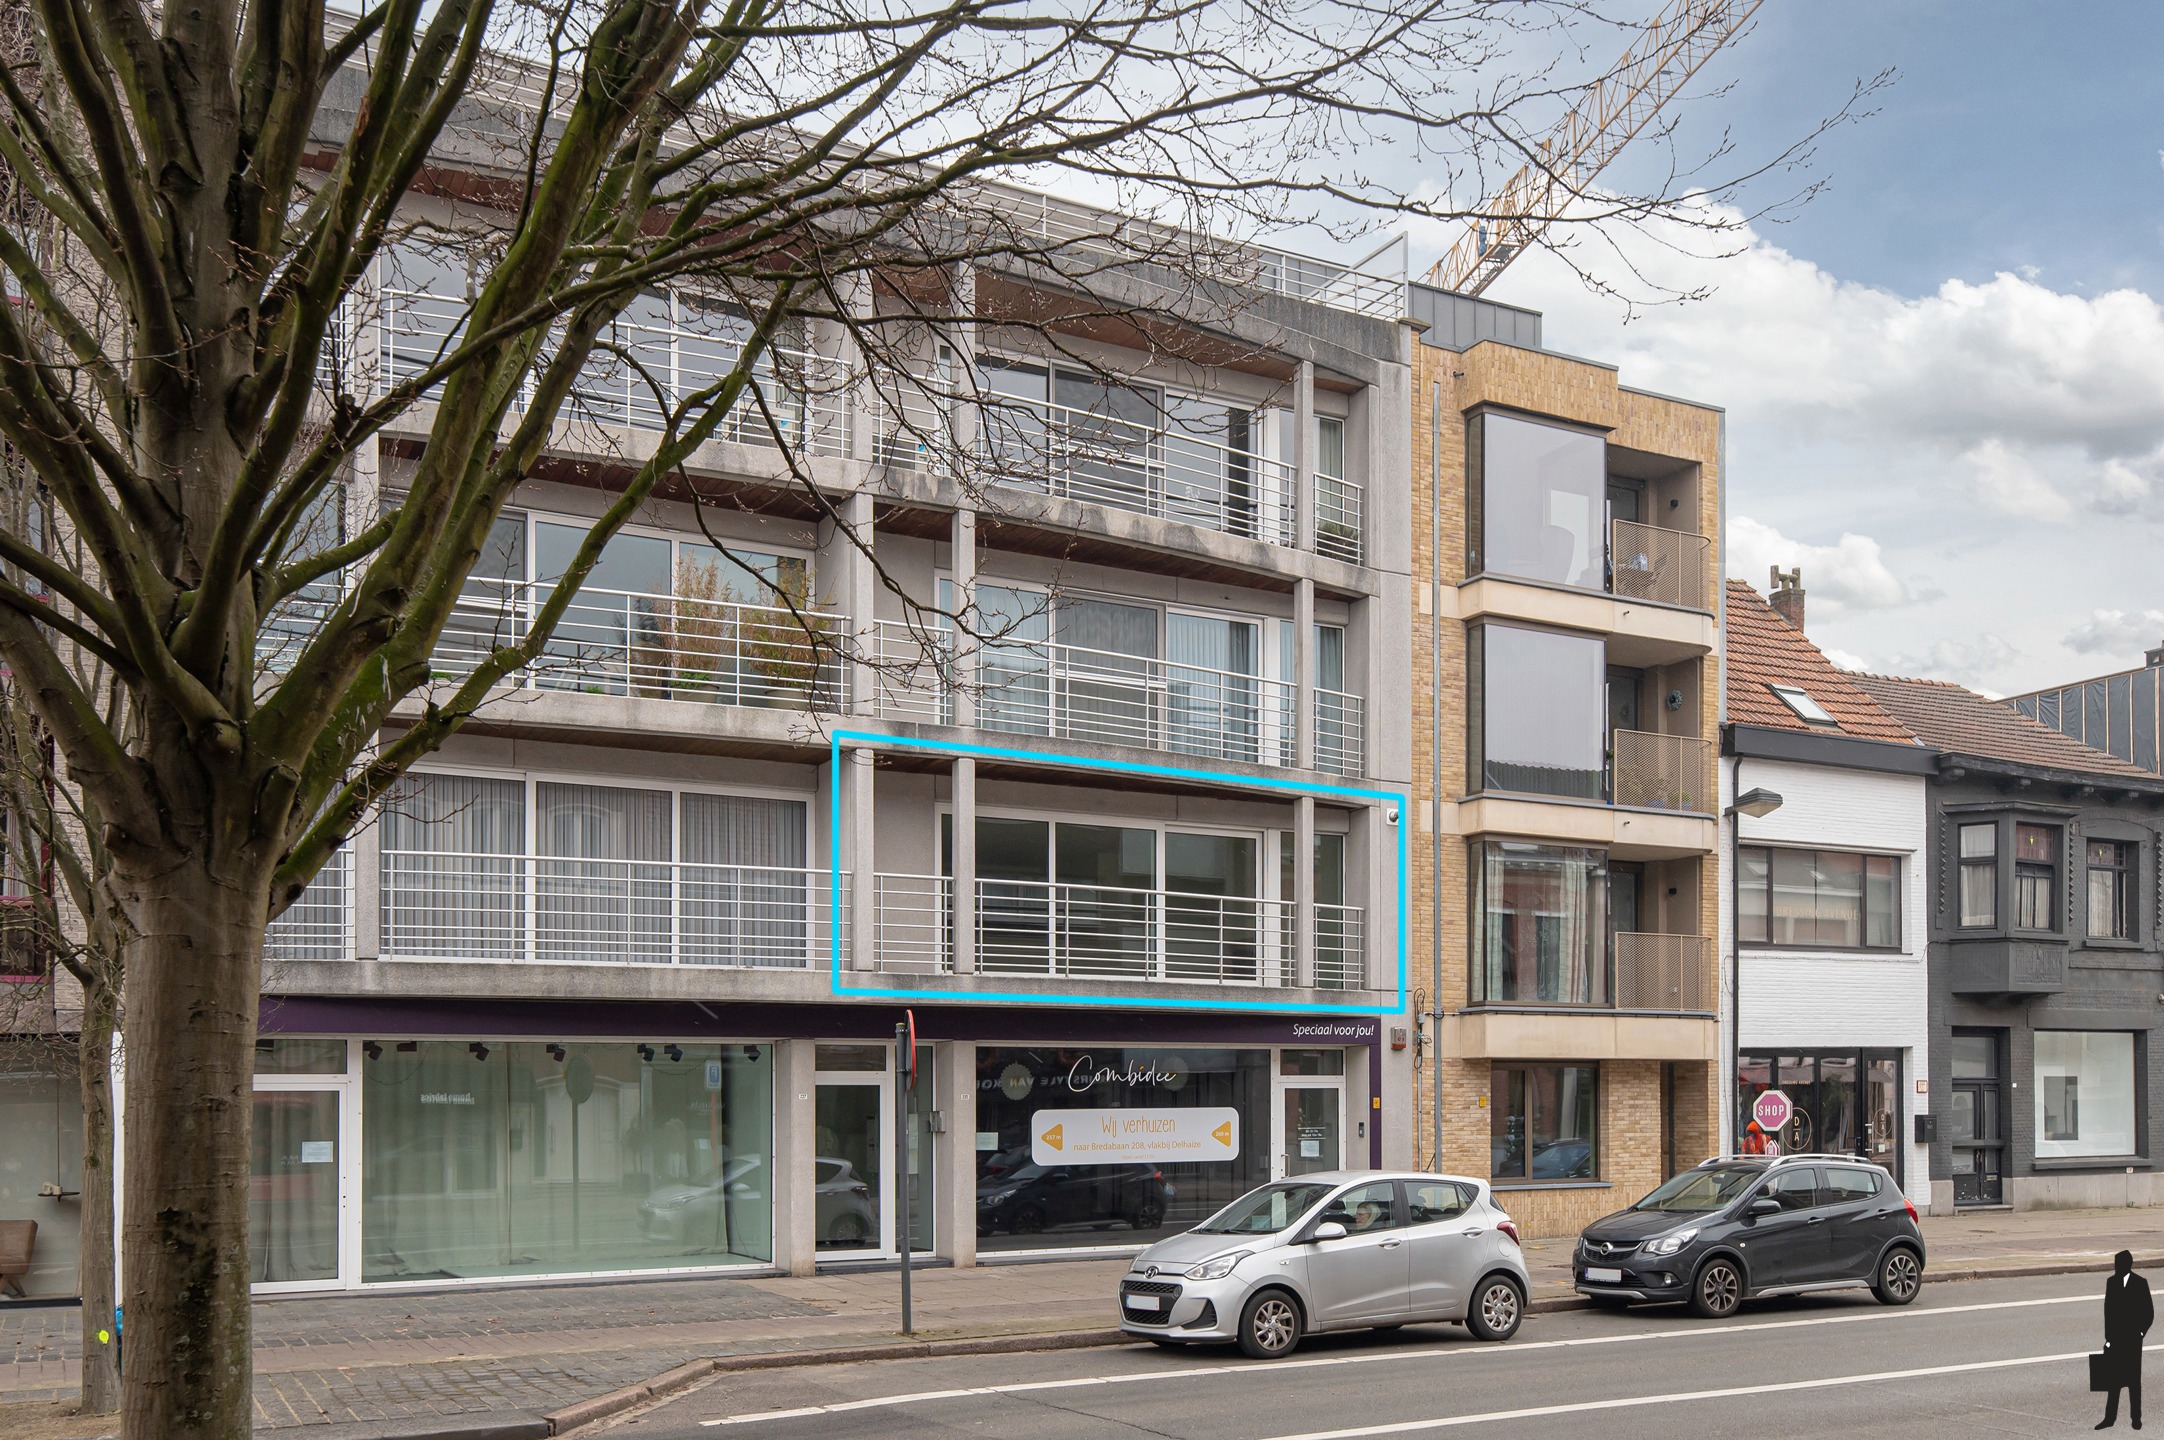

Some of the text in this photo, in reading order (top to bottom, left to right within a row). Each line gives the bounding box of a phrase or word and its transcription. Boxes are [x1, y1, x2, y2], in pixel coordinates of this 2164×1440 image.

[1824, 908, 1858, 920] AVENUE
[1293, 1023, 1375, 1038] Speciaal voor jou!
[1068, 1054, 1177, 1093] Combidee
[1758, 1104, 1785, 1117] SHOP
[1101, 1115, 1176, 1138] Wij verhuizen
[1091, 1142, 1130, 1151] Bredabaan
[1147, 1141, 1171, 1151] vlakbij
[1171, 1140, 1202, 1149] Delhaize
